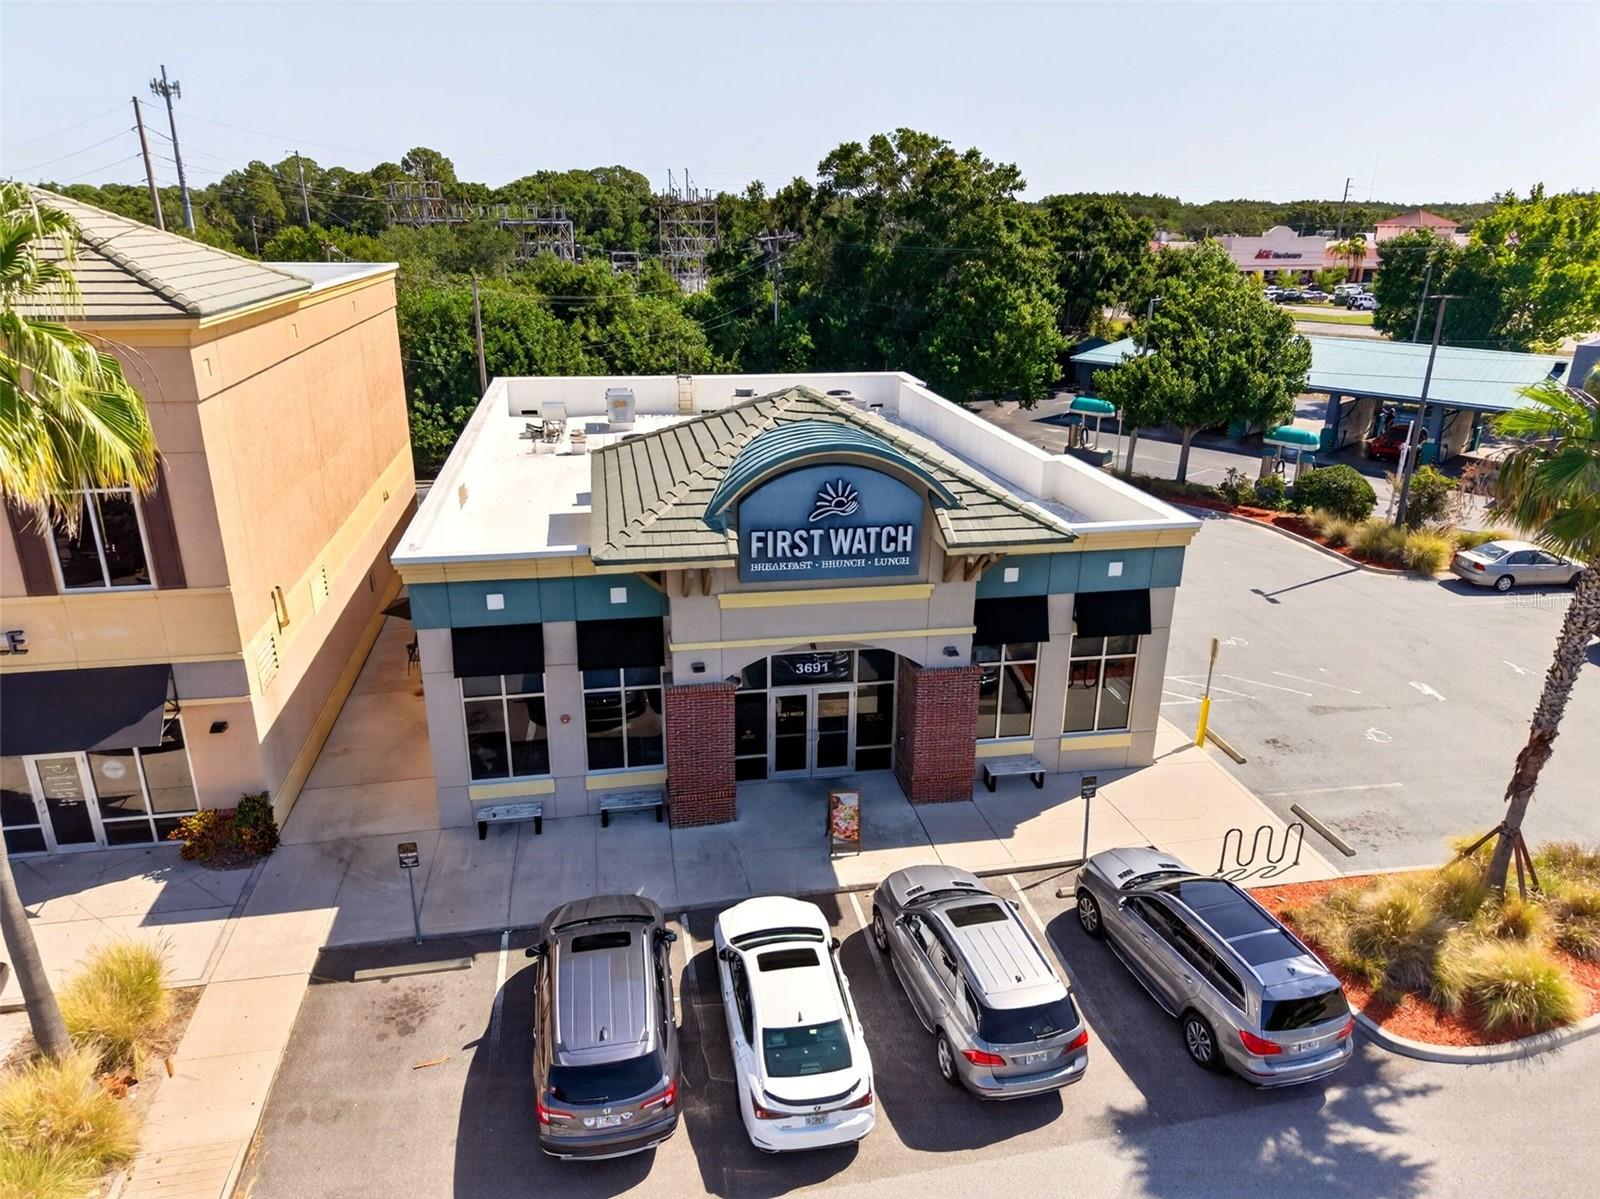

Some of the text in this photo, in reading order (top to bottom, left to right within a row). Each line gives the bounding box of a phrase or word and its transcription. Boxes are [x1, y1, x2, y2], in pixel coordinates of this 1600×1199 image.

[750, 525, 913, 558] FIRST WATCH
[751, 557, 910, 572] BREAKFAST BRUNCH LUNCH
[795, 662, 829, 674] 3691
